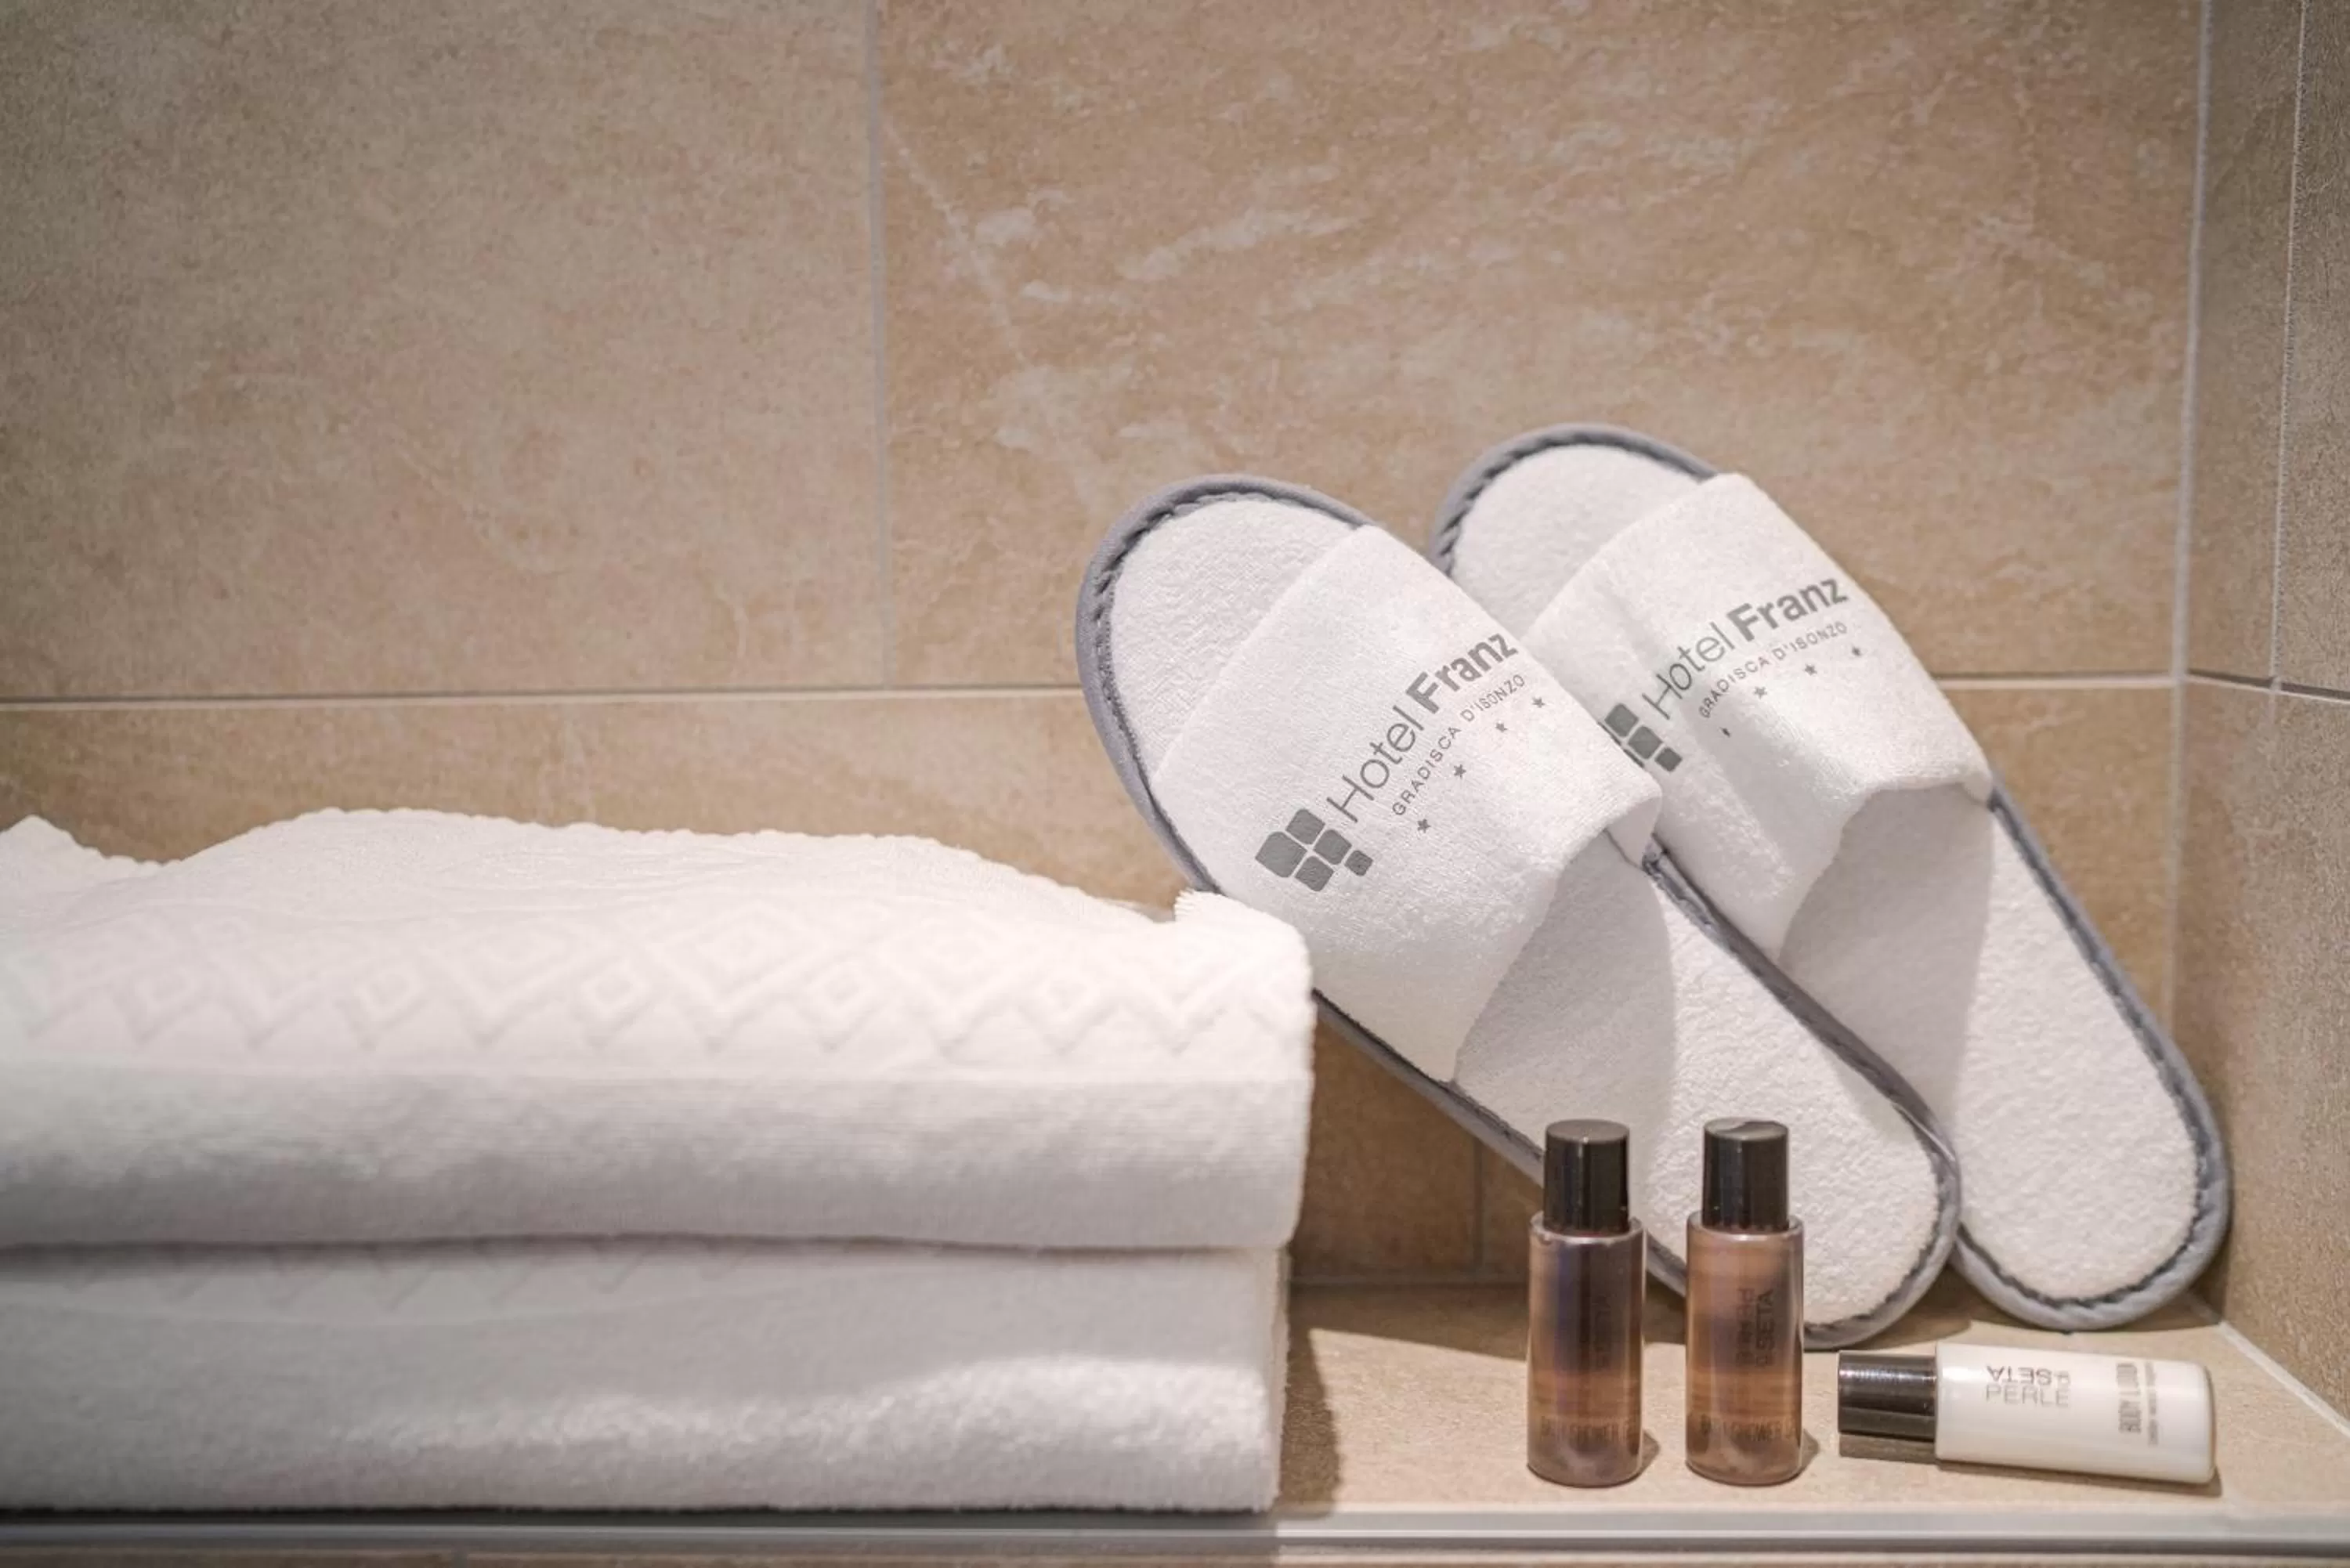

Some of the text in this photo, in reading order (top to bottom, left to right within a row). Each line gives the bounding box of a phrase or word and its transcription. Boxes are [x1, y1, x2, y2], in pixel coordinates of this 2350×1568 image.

[1642, 579, 1849, 720] Hotel Franz
[1698, 621, 1847, 718] GRADISCA D'ISONZO
[1326, 634, 1518, 823] Hotel Franz
[1392, 674, 1525, 815] GRADISCA D'ISONZO
[1986, 1384, 2070, 1407] PERLE
